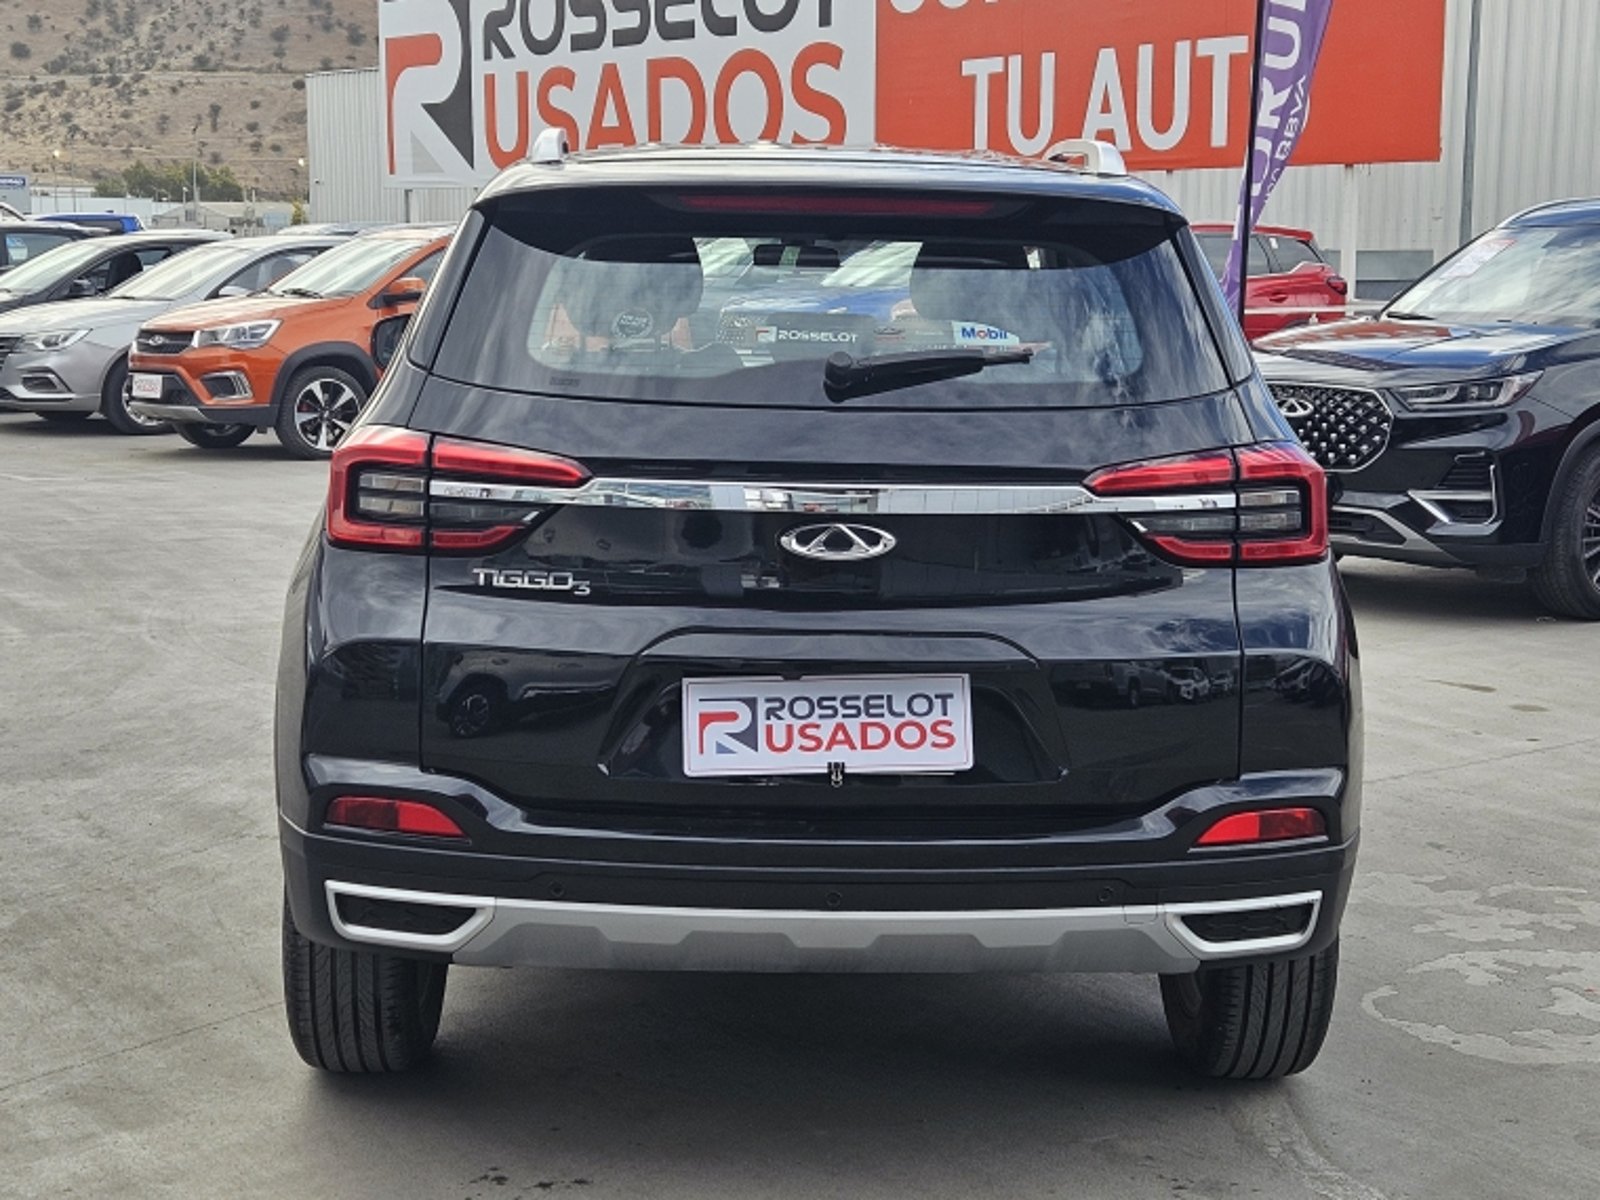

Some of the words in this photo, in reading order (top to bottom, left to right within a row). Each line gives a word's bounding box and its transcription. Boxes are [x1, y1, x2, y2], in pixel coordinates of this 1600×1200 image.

[484, 42, 847, 172] USADOS
[962, 52, 1056, 157] TU
[1081, 35, 1310, 152] AUT
[777, 328, 859, 344] ROSSELOT
[961, 327, 1008, 340] Mobil
[764, 693, 954, 721] ROSSELOT
[764, 720, 956, 753] USADOS
